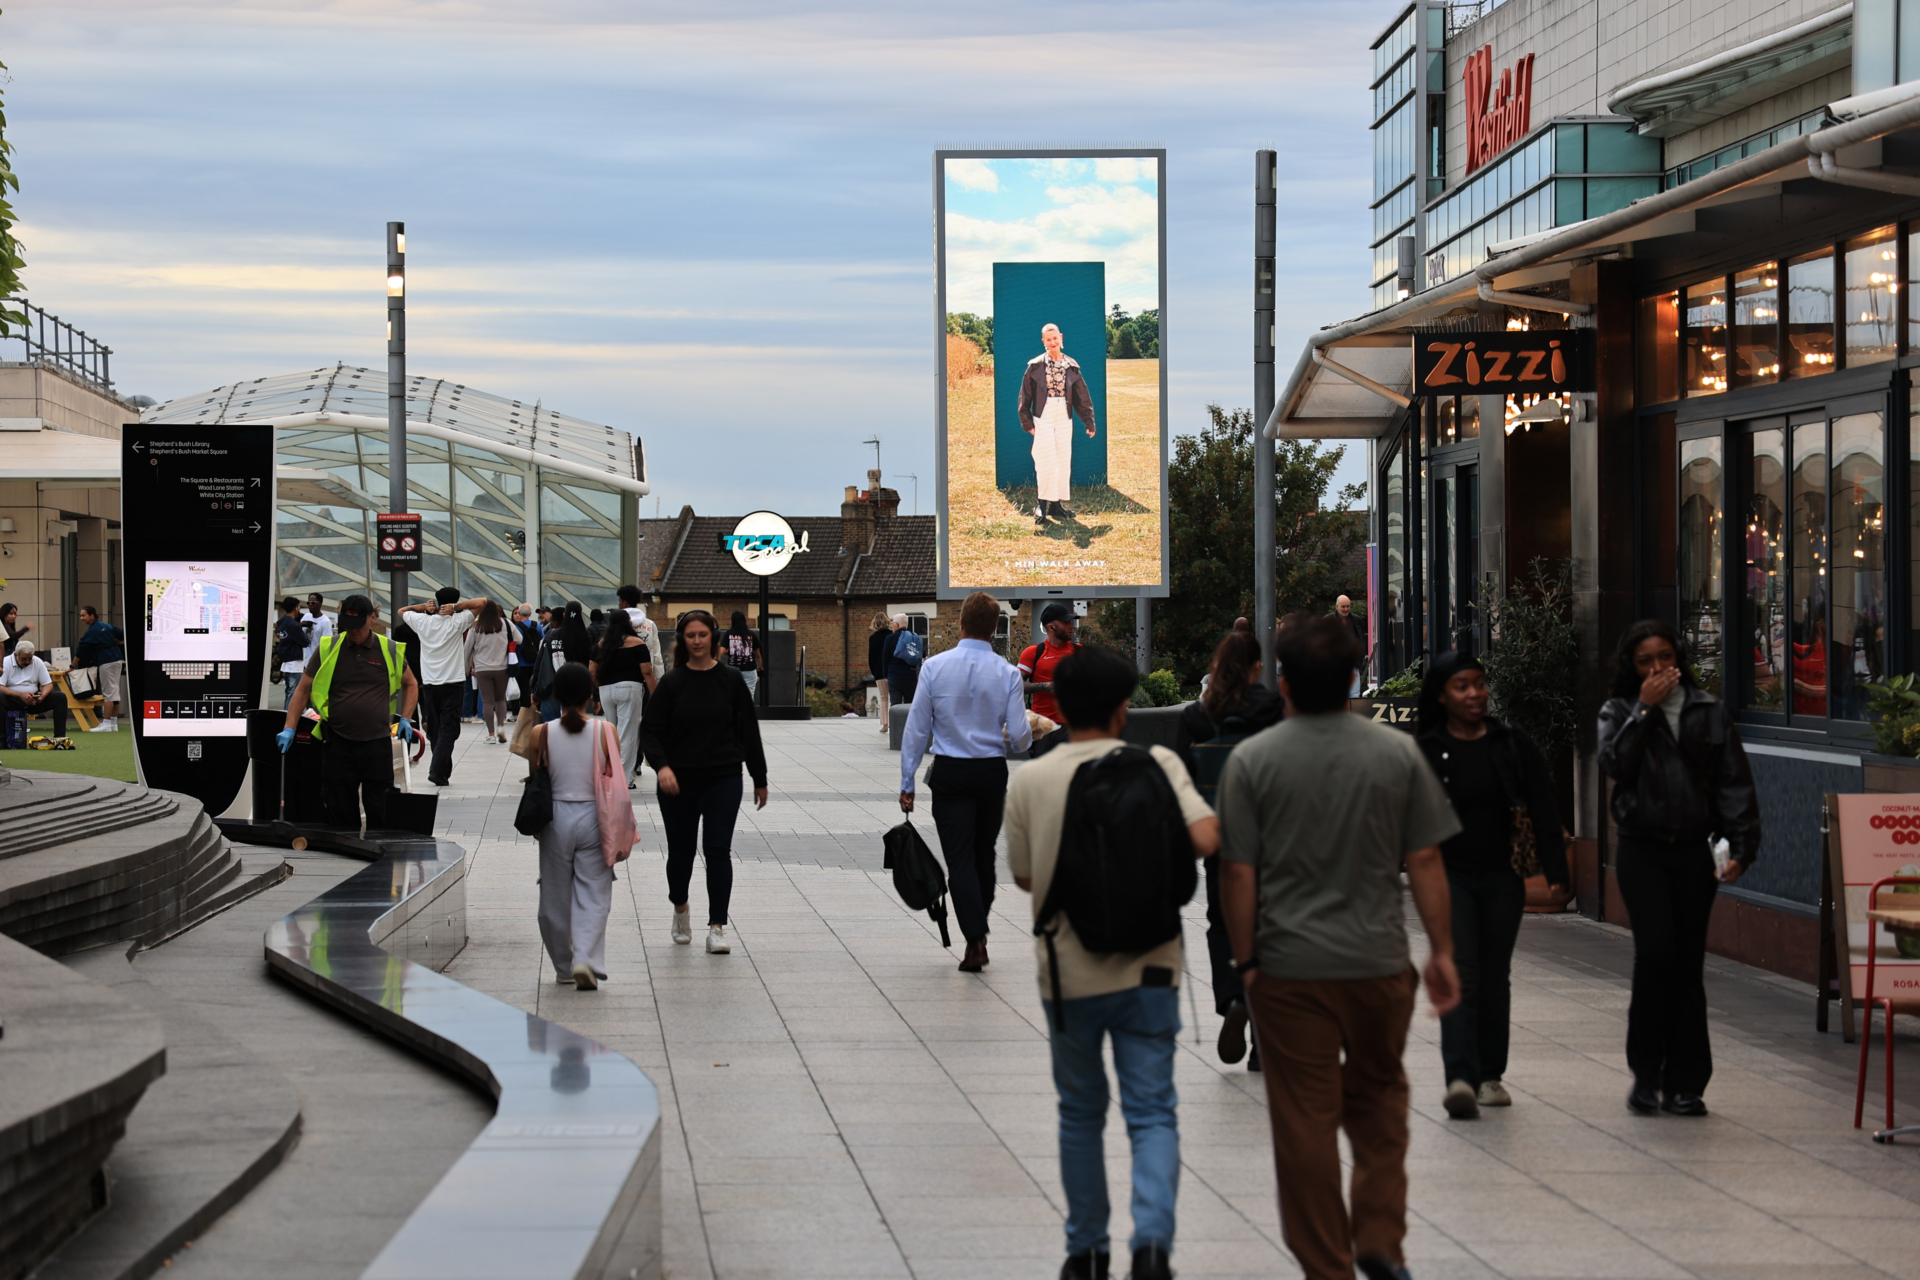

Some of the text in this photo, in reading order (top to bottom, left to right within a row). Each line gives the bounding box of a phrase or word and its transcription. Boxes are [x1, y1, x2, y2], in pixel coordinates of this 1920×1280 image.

[1463, 45, 1535, 177] Westfield
[1424, 340, 1566, 387] Zizzi
[723, 535, 784, 550] TOCA
[742, 530, 810, 562] Social
